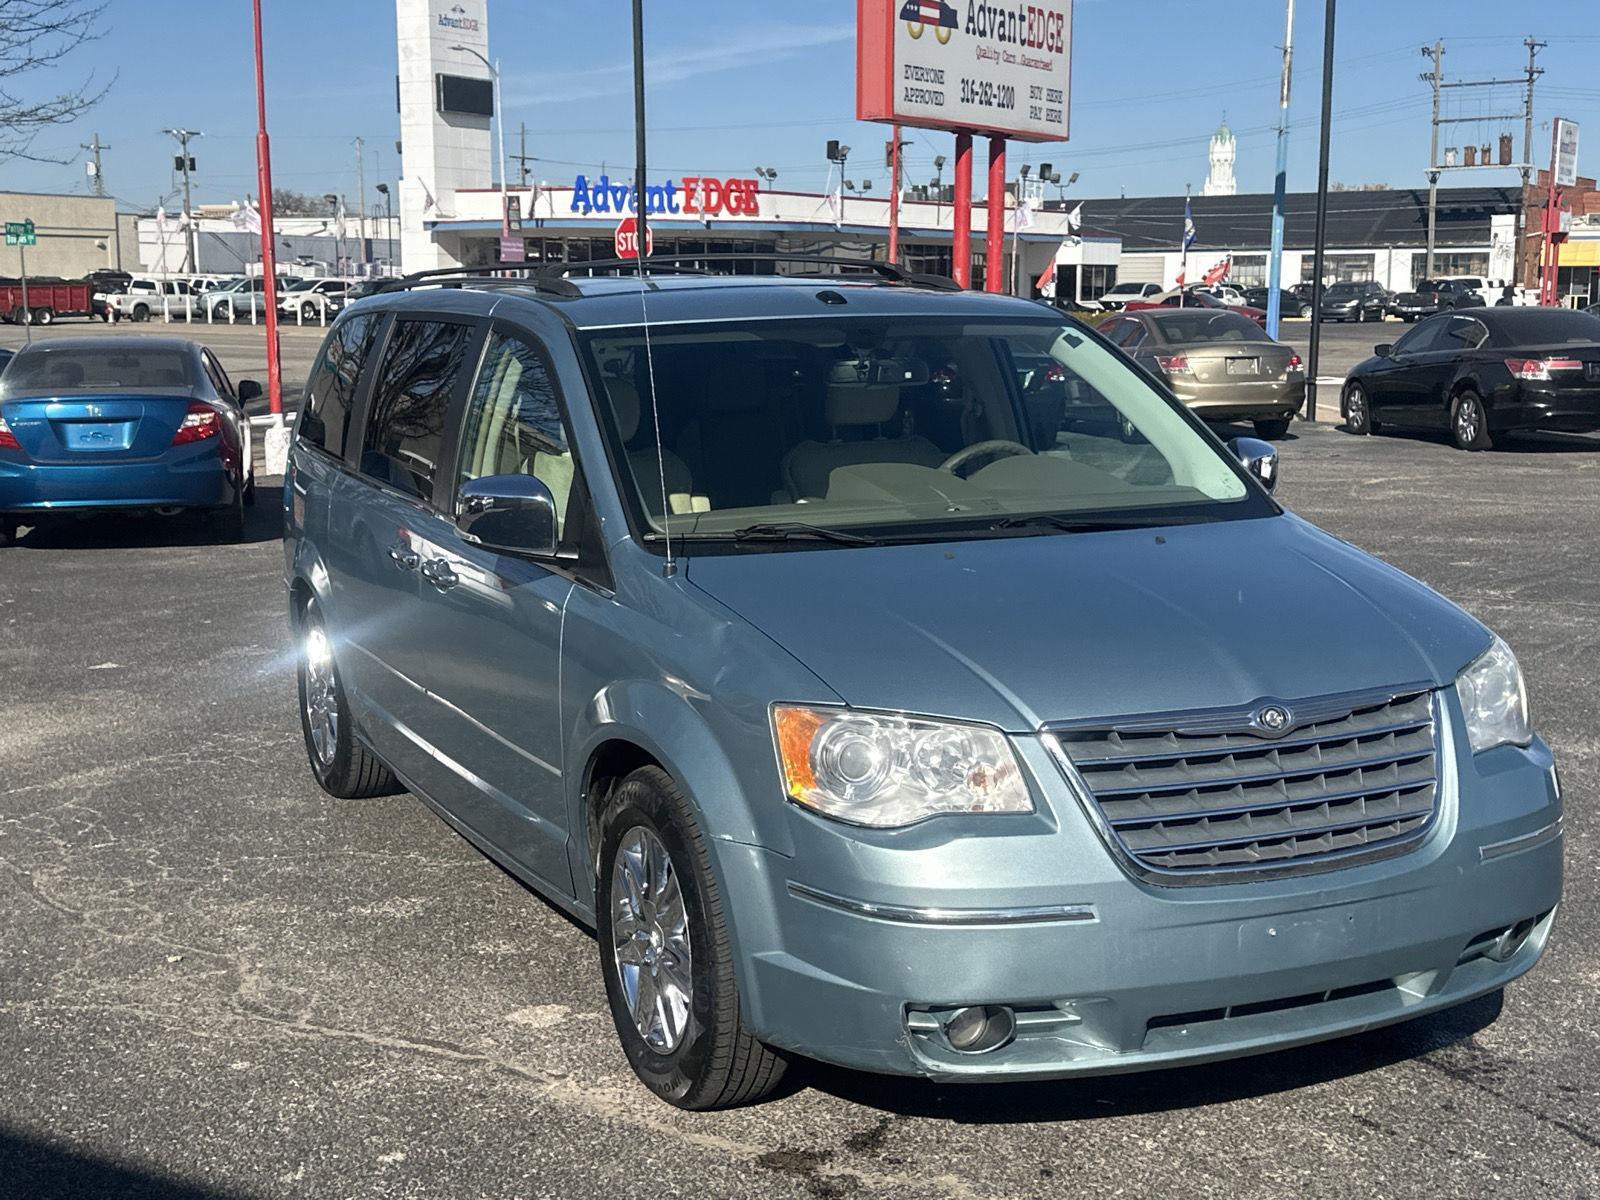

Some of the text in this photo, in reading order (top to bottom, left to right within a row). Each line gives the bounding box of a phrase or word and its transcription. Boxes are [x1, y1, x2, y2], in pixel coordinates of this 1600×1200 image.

[976, 45, 1000, 64] Quality
[904, 64, 945, 84] EVERYONE
[904, 87, 945, 107] APPROVED
[960, 78, 1015, 110] 316-262-1200
[1030, 85, 1063, 104] BUY HERE
[1029, 105, 1063, 124] PAY HERE
